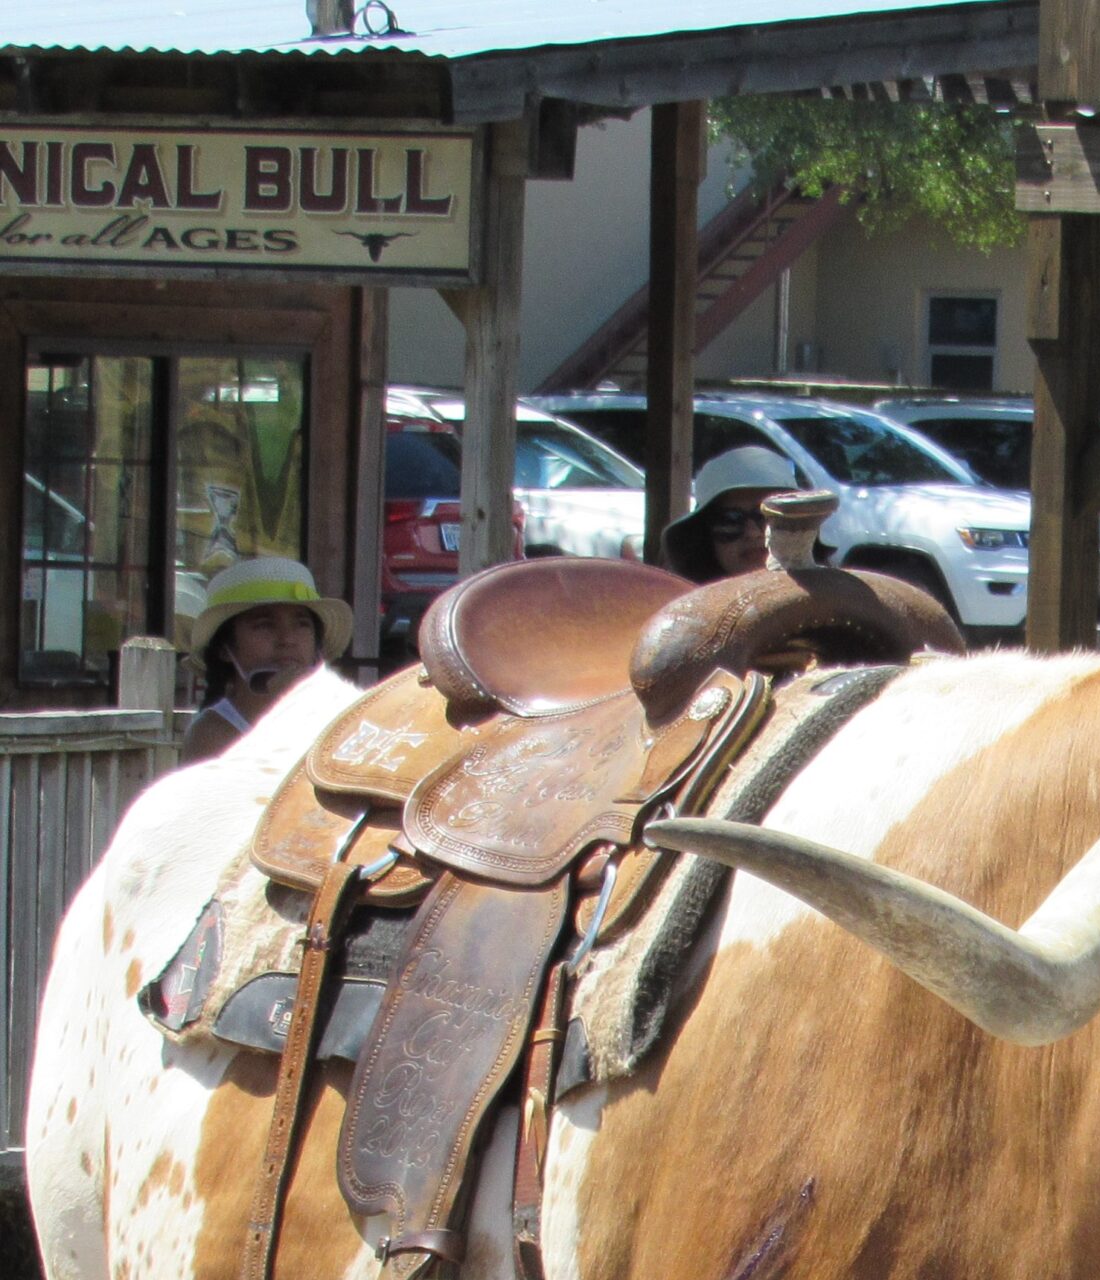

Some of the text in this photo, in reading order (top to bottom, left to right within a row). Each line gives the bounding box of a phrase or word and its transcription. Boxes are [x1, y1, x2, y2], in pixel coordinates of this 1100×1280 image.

[0, 140, 454, 217] NICAL BULL
[61, 214, 149, 248] all
[142, 226, 299, 253] AGES
